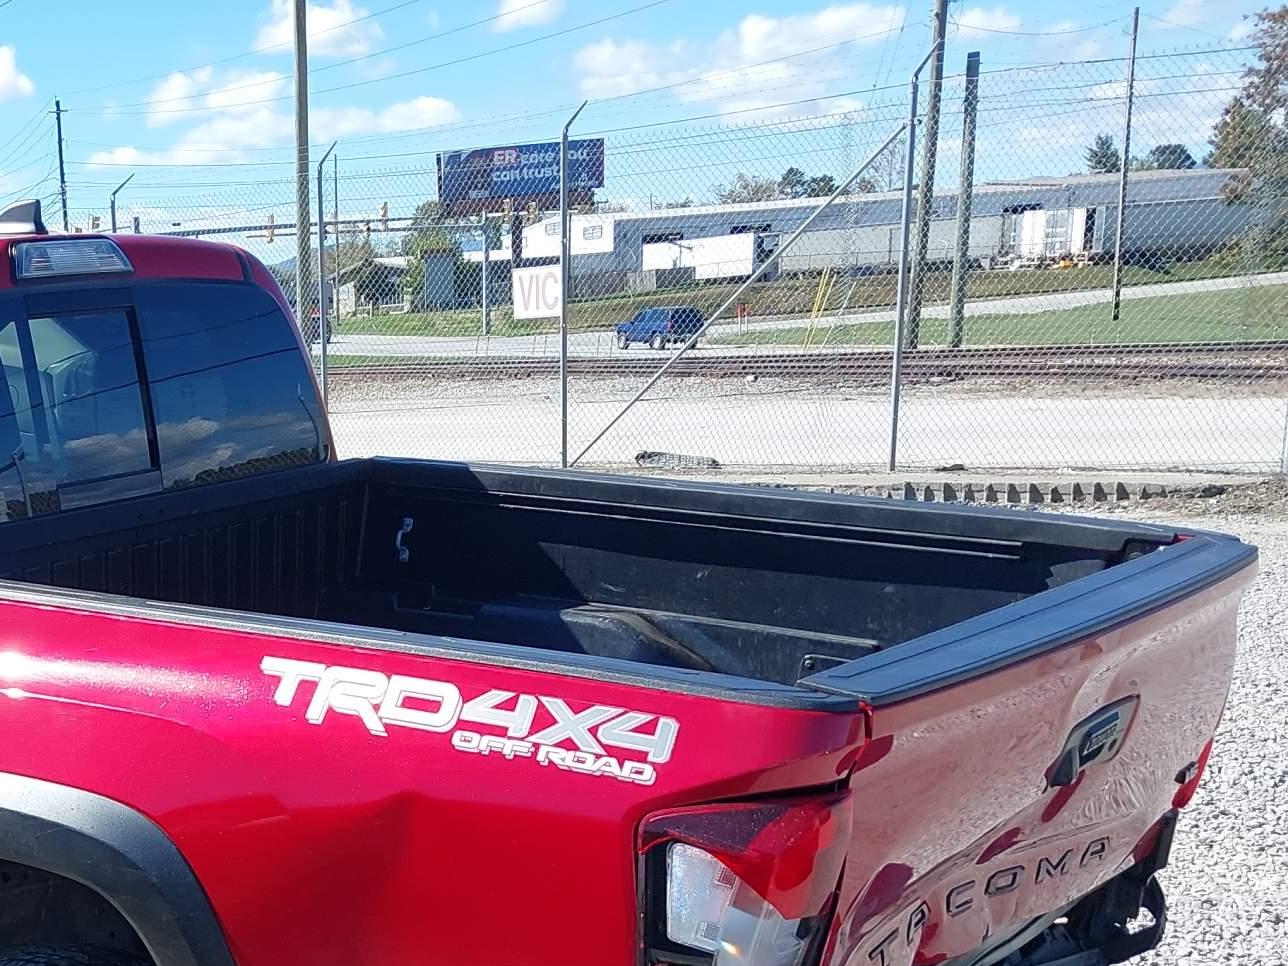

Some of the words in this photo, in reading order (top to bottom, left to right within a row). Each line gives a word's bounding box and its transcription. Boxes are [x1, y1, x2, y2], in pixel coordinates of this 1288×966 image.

[491, 168, 521, 182] can
[523, 163, 560, 179] trust
[493, 149, 517, 165] ER
[518, 272, 559, 312] VIC
[260, 655, 462, 738] TRD
[459, 688, 679, 764] 4X4
[451, 730, 535, 762] OFF
[535, 744, 657, 785] ROAD
